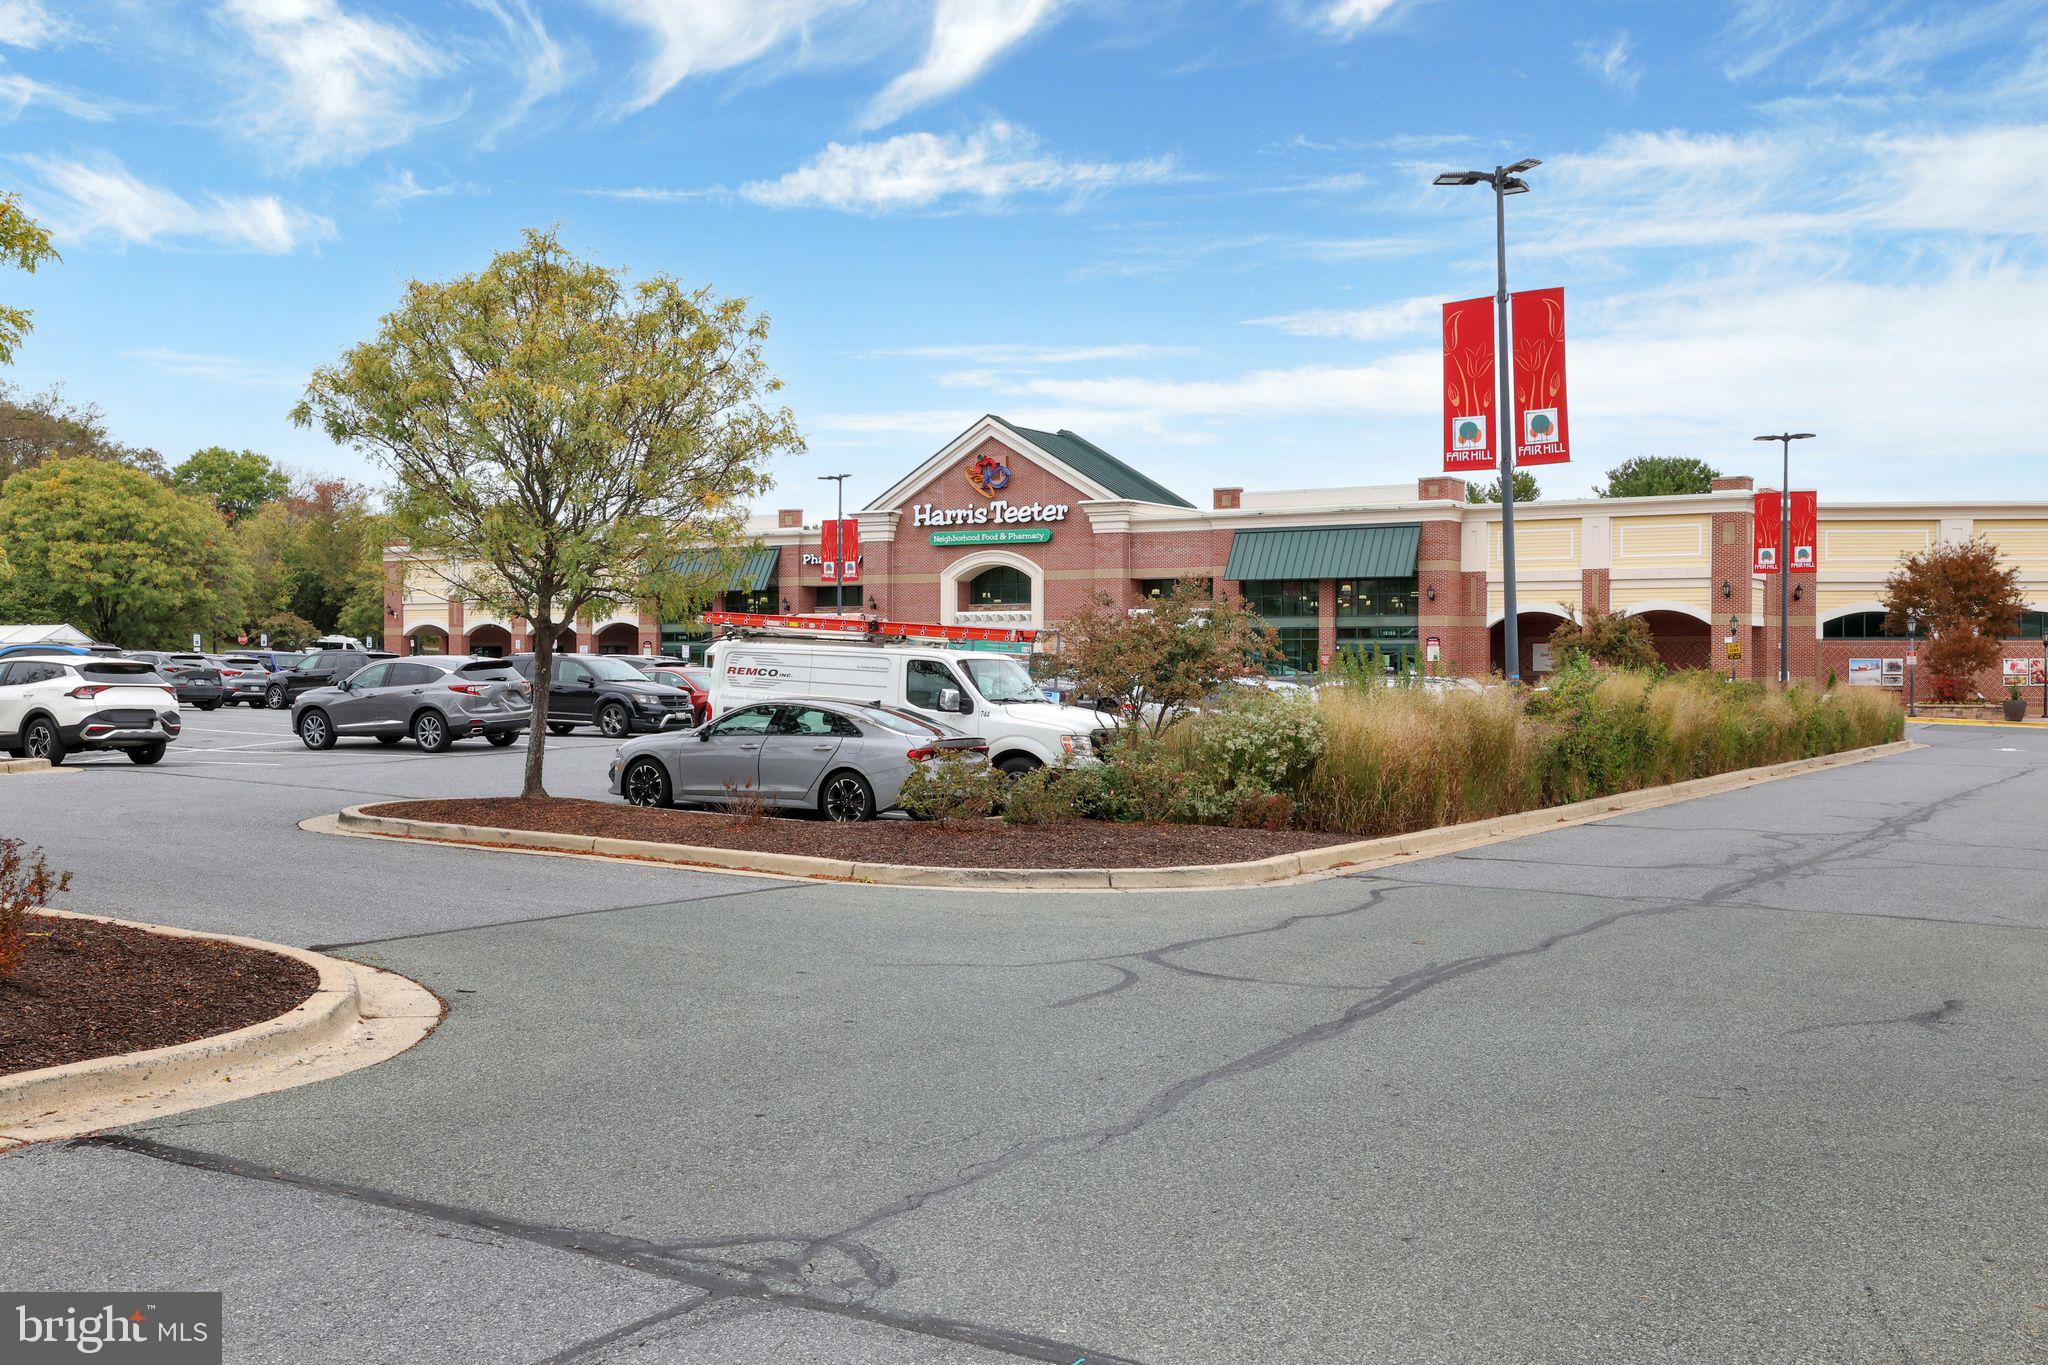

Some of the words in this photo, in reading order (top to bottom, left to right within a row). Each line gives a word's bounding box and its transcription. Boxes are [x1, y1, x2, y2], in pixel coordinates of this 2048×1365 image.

[1446, 451, 1470, 462] FAIR
[1470, 450, 1493, 461] HILL
[1518, 445, 1543, 457] FAIR
[1543, 443, 1566, 455] HILL
[912, 502, 988, 527] Harris
[990, 500, 1069, 524] Teeter
[933, 534, 980, 544] Neighborhood
[981, 533, 998, 541] Food
[999, 532, 1006, 540] &
[1008, 531, 1045, 542] Pharmacy
[727, 666, 779, 678] REMCO
